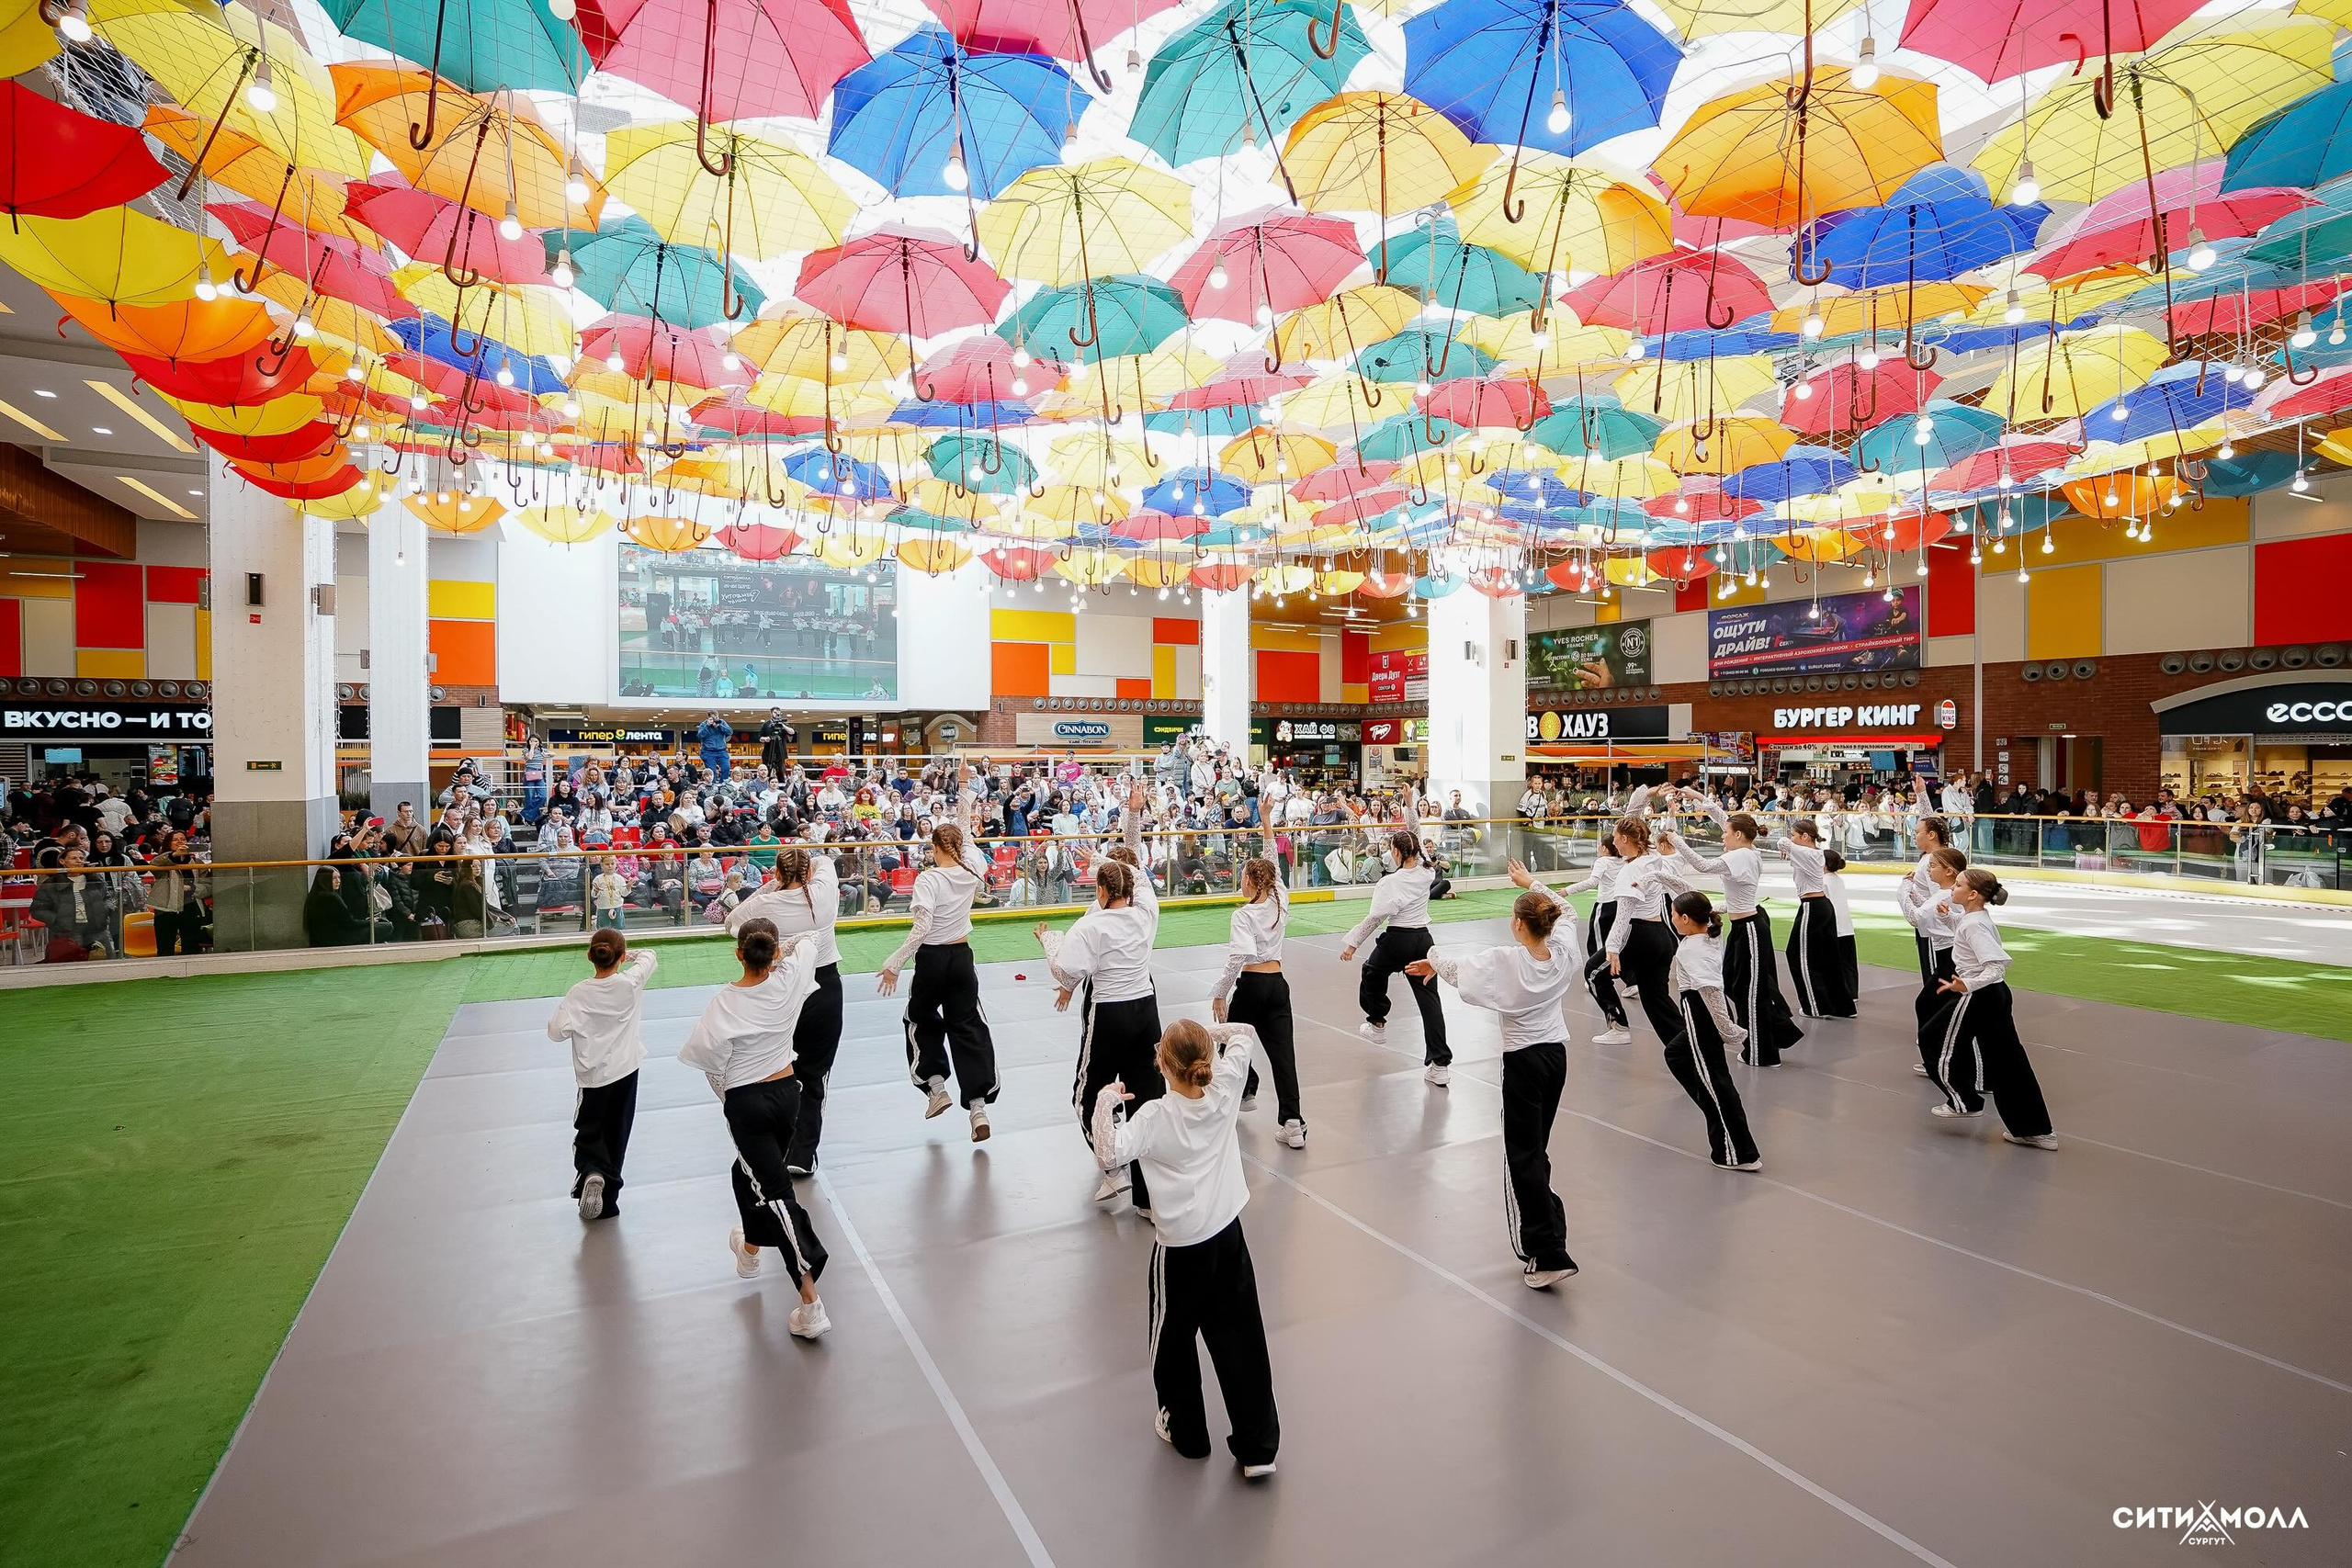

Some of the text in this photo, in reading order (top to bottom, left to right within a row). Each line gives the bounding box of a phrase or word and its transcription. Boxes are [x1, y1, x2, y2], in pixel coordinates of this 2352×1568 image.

[1713, 620, 1767, 640] ОЩУТИ
[1553, 634, 1599, 645] YVES ROCHER
[1713, 636, 1771, 659] ДРАЙВ!
[1753, 651, 1794, 661] ИНТЕРАКТИВНЫЙ
[1794, 647, 1826, 656] АЭРОХОККЕЙ
[1855, 637, 1903, 649] СТРАЙКБОЛЬНЫЙ
[1372, 671, 1388, 682] Двери
[1387, 670, 1401, 681] Дуэт
[1773, 704, 1921, 728] БУРГЕР КИНГ
[2267, 700, 2352, 723] ecco
[4, 711, 122, 728] ВКУСНО
[150, 712, 171, 728] И
[176, 712, 213, 728] ТО
[1562, 713, 1609, 738] ХАУЗ
[579, 731, 662, 741] гипер лента
[822, 732, 877, 740] гипе ле
[1057, 724, 1107, 735] CINNABON
[1186, 723, 1204, 738] SU
[1294, 722, 1336, 735] ХАЙ ФО
[1769, 743, 1793, 751] Скидки
[1803, 742, 1818, 750] 40%
